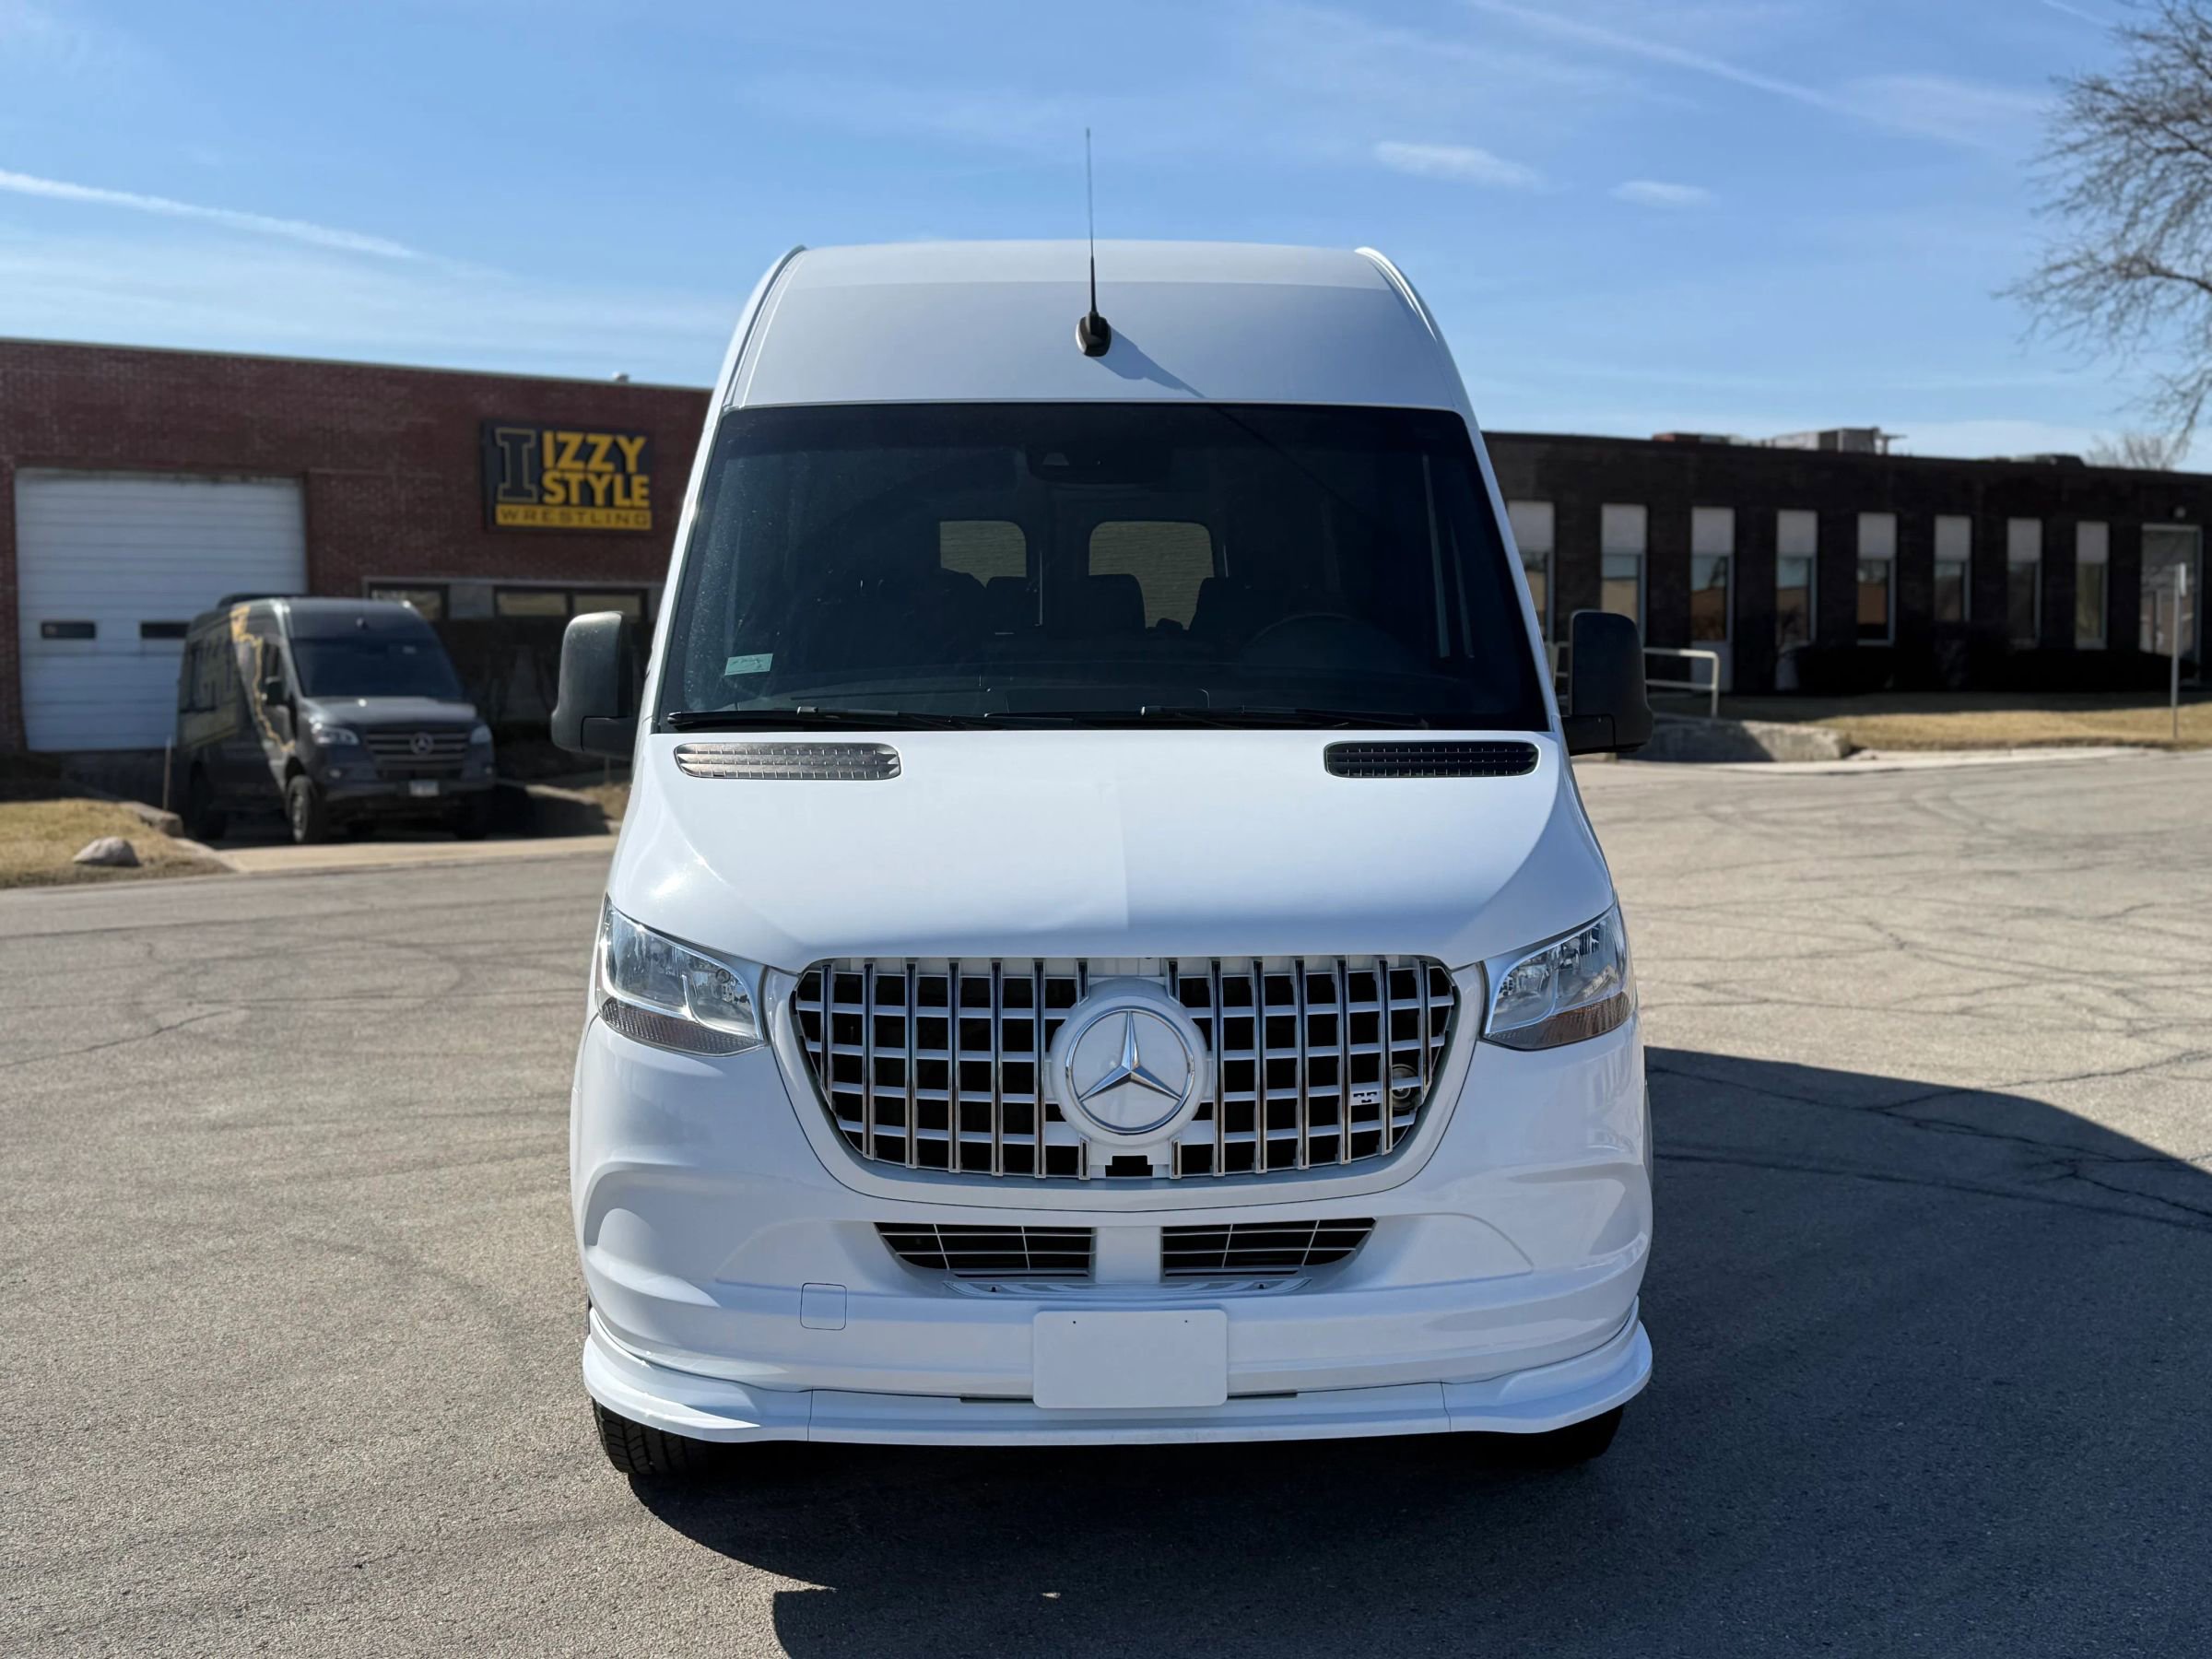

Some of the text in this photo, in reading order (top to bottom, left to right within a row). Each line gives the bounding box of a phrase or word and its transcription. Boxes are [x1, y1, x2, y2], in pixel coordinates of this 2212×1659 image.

[495, 427, 538, 504] I
[542, 429, 647, 473] IZZY
[542, 469, 650, 508] STYLE
[500, 508, 649, 525] WRESTLING
